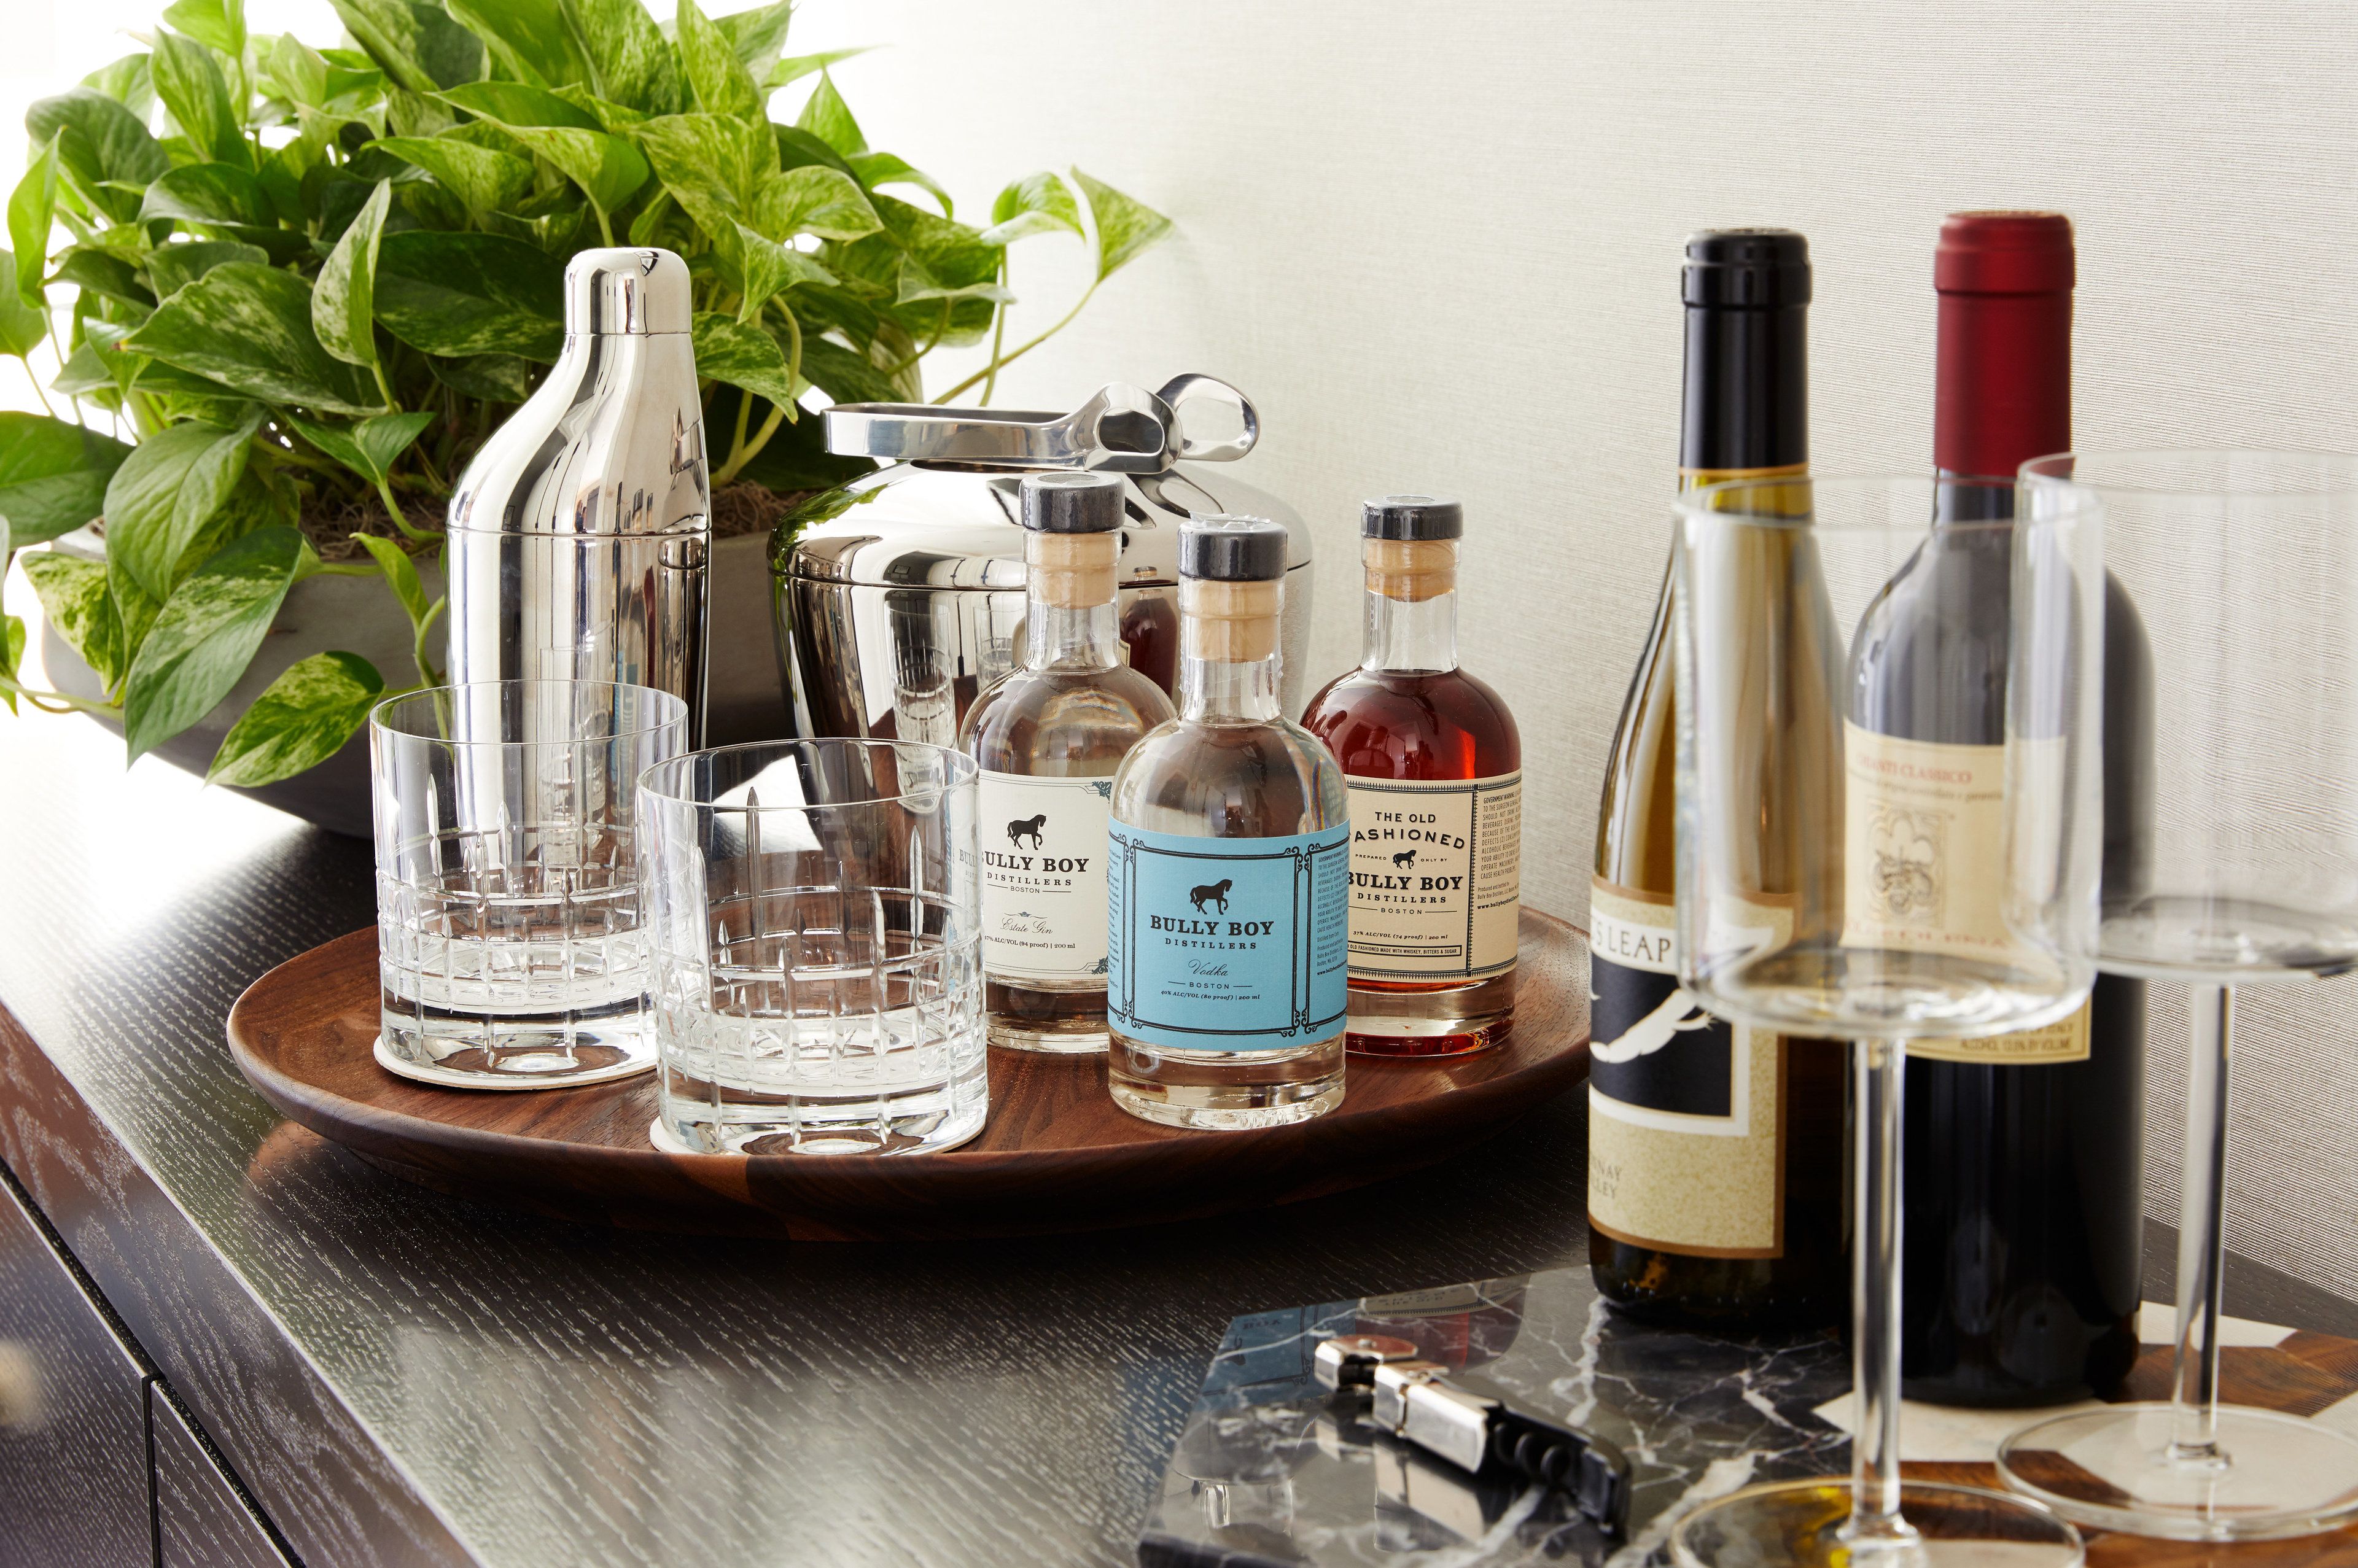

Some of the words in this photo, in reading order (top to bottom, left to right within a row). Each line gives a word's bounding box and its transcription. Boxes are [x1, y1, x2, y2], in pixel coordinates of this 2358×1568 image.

[1484, 794, 1504, 804] GOVERNMENT
[1496, 802, 1509, 810] SURGEON
[1375, 812, 1403, 822] THE
[1409, 813, 1436, 823] OLD
[1483, 812, 1497, 821] SHOULD
[1482, 820, 1503, 829] BEVERAGES
[1482, 829, 1498, 837] BECAUSE
[1350, 829, 1465, 849] ASHIONED
[1482, 837, 1499, 846] DEFECTS
[1482, 845, 1501, 855] ALCOHOLIC
[1493, 852, 1504, 861] ABILITY
[1043, 858, 1089, 872] BOY
[1481, 862, 1497, 871] OPERATE
[1493, 869, 1504, 877] HEALTH
[987, 872, 1072, 886] DISTILLERS
[1420, 876, 1463, 890] BOY
[1318, 893, 1330, 902] DEFECTS
[1358, 893, 1446, 903] DISTILLERS
[1000, 917, 1029, 933] Estate
[1032, 920, 1054, 934] Gin
[1151, 915, 1219, 935] BULLY
[1228, 921, 1274, 936] BOY
[994, 937, 1019, 945] ALC/VOL
[1165, 937, 1256, 949] DISTILLERS
[1608, 925, 1671, 963] LEAP
[1188, 959, 1229, 976] Vodka
